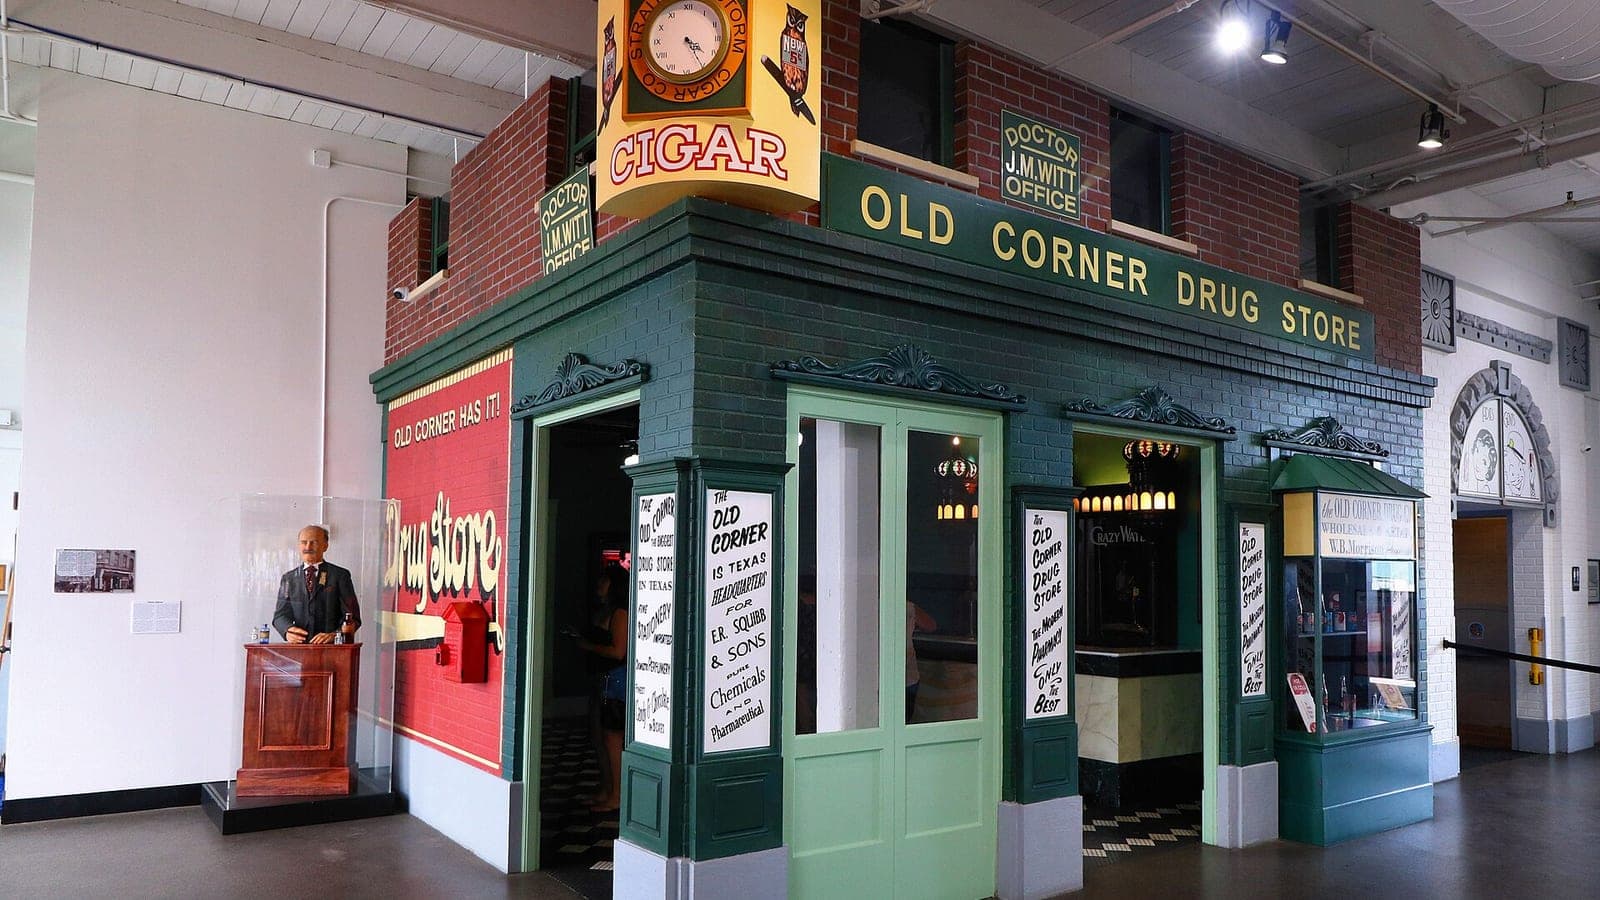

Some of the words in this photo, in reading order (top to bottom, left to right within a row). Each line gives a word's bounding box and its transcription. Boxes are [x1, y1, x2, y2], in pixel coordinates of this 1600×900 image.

[642, 72, 667, 95] CO
[674, 68, 731, 101] CIGAR
[610, 124, 787, 185] CIGAR
[1004, 123, 1078, 168] DOCTOR
[542, 183, 588, 231] DOCTOR
[1005, 176, 1076, 213] OFFICE
[546, 237, 590, 275] OFFICE
[860, 185, 955, 245] OLD
[991, 220, 1148, 296] CORNER
[1177, 270, 1260, 323] DRUG
[1281, 300, 1361, 350] STORE
[394, 424, 412, 449] OLD
[415, 409, 456, 442] CORNER
[459, 399, 481, 428] HAS
[485, 391, 500, 420] IT!
[714, 490, 728, 504] THE
[1333, 497, 1350, 519] OLD
[1352, 499, 1381, 521] CORNER
[652, 496, 675, 533] CORNER
[712, 505, 741, 530] OLD
[711, 521, 768, 555] CORNER
[1032, 526, 1052, 547] OLD
[1241, 537, 1256, 554] OLD
[384, 498, 428, 613] Drug
[712, 566, 724, 580] IS
[728, 552, 767, 574] TEXAS
[1032, 540, 1062, 570] CORNER
[1241, 549, 1263, 573] CORNER
[650, 581, 673, 591] TEXAS
[711, 571, 768, 607] HEADQUARTERS
[1032, 562, 1061, 592] DRUG
[1242, 567, 1262, 592] DRUG
[725, 598, 753, 616] FOR
[1033, 580, 1062, 613] STORE
[1243, 582, 1263, 609] STORE
[732, 607, 767, 634] SQUIBB
[1041, 604, 1064, 634] MODERN
[711, 655, 724, 669] &
[727, 632, 766, 662] SONS
[1031, 626, 1063, 668] PHARMACY
[1247, 649, 1264, 674] ONLY
[726, 663, 750, 680] PURE
[1038, 661, 1062, 690] ONLY
[1243, 676, 1263, 694] BEST
[710, 666, 766, 709] Chemicals
[725, 698, 752, 716] AND
[1033, 693, 1062, 714] BEST
[710, 699, 765, 743] Pharmaceutical
